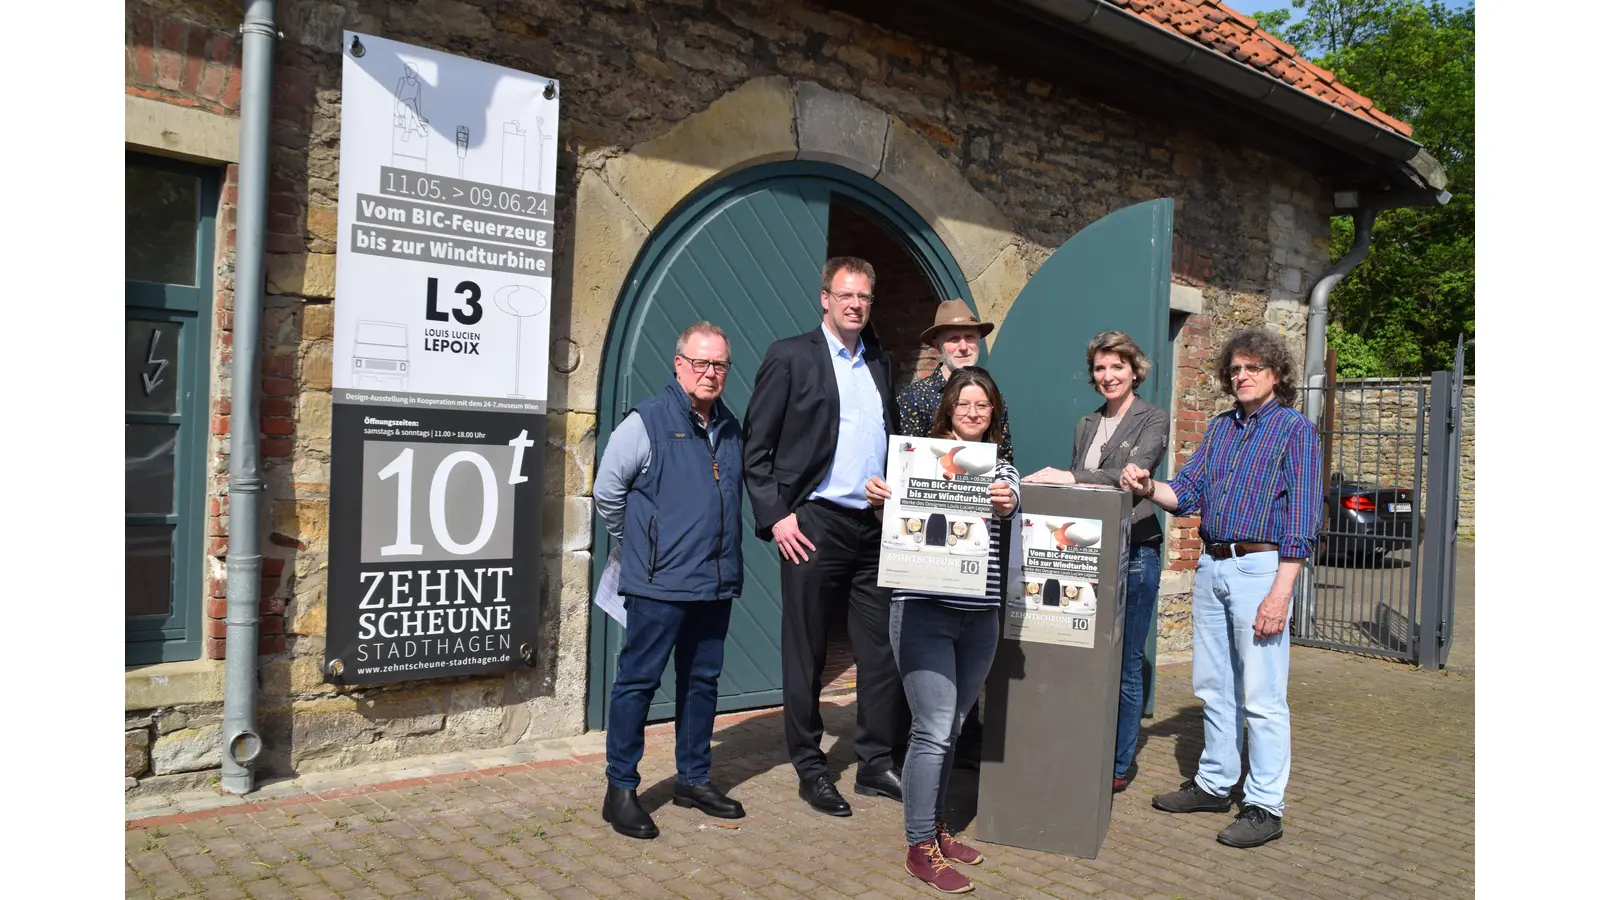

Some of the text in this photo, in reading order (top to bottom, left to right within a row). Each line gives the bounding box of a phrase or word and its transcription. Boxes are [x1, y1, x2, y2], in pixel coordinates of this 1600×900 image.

[386, 173, 446, 200] 11.05.
[469, 187, 548, 216] 09.06.24
[360, 200, 547, 247] Vom BIC-Feuerzeug
[356, 230, 546, 271] bis zur Windturbine
[425, 276, 483, 326] L3
[424, 328, 481, 341] LOUIS LUCIEN
[424, 338, 480, 355] LEPOIX
[345, 393, 408, 404] Design-Ausstellung
[417, 397, 456, 406] Kooperation
[364, 416, 419, 427] Öffnungszeiten:
[363, 428, 394, 436] samstags
[401, 430, 430, 438] sonntags
[474, 431, 486, 439] Uhr
[910, 479, 991, 495] Vom BIC-Feuerzeug
[909, 490, 922, 498] bis
[938, 492, 991, 504] Windturbine
[1046, 551, 1098, 564] BIC-Feuerzeug
[1053, 561, 1098, 571] Windturbine
[358, 567, 513, 609] ZEHNT
[358, 605, 511, 640] SCHEUNE
[357, 634, 511, 662] STADTHAGEN
[357, 653, 510, 675] www.zehntscheune-stadthagen.de
